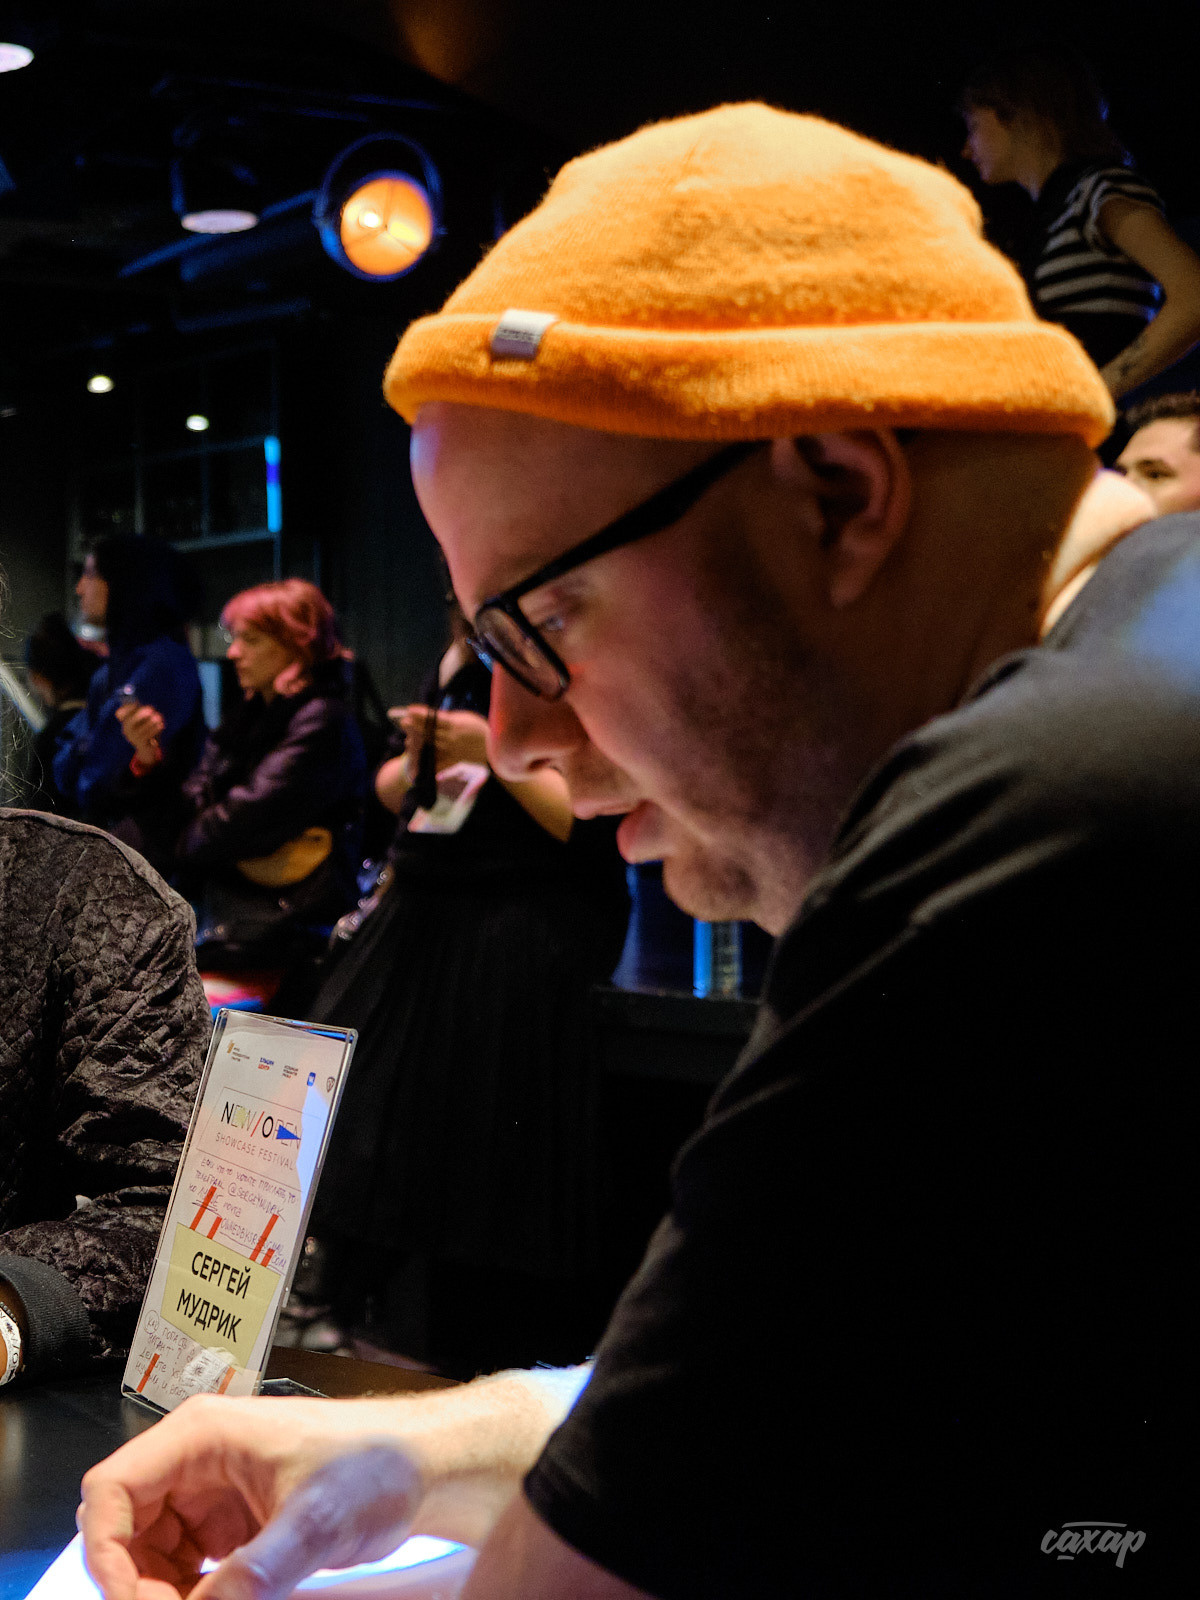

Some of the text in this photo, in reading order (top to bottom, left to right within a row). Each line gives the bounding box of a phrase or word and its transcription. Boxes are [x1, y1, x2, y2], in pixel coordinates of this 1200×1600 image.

[216, 1132, 293, 1171] SHOWCASE FESTIVAL
[191, 1251, 251, 1299] СЕРГЕЙ
[176, 1288, 242, 1343] МУДРИК
